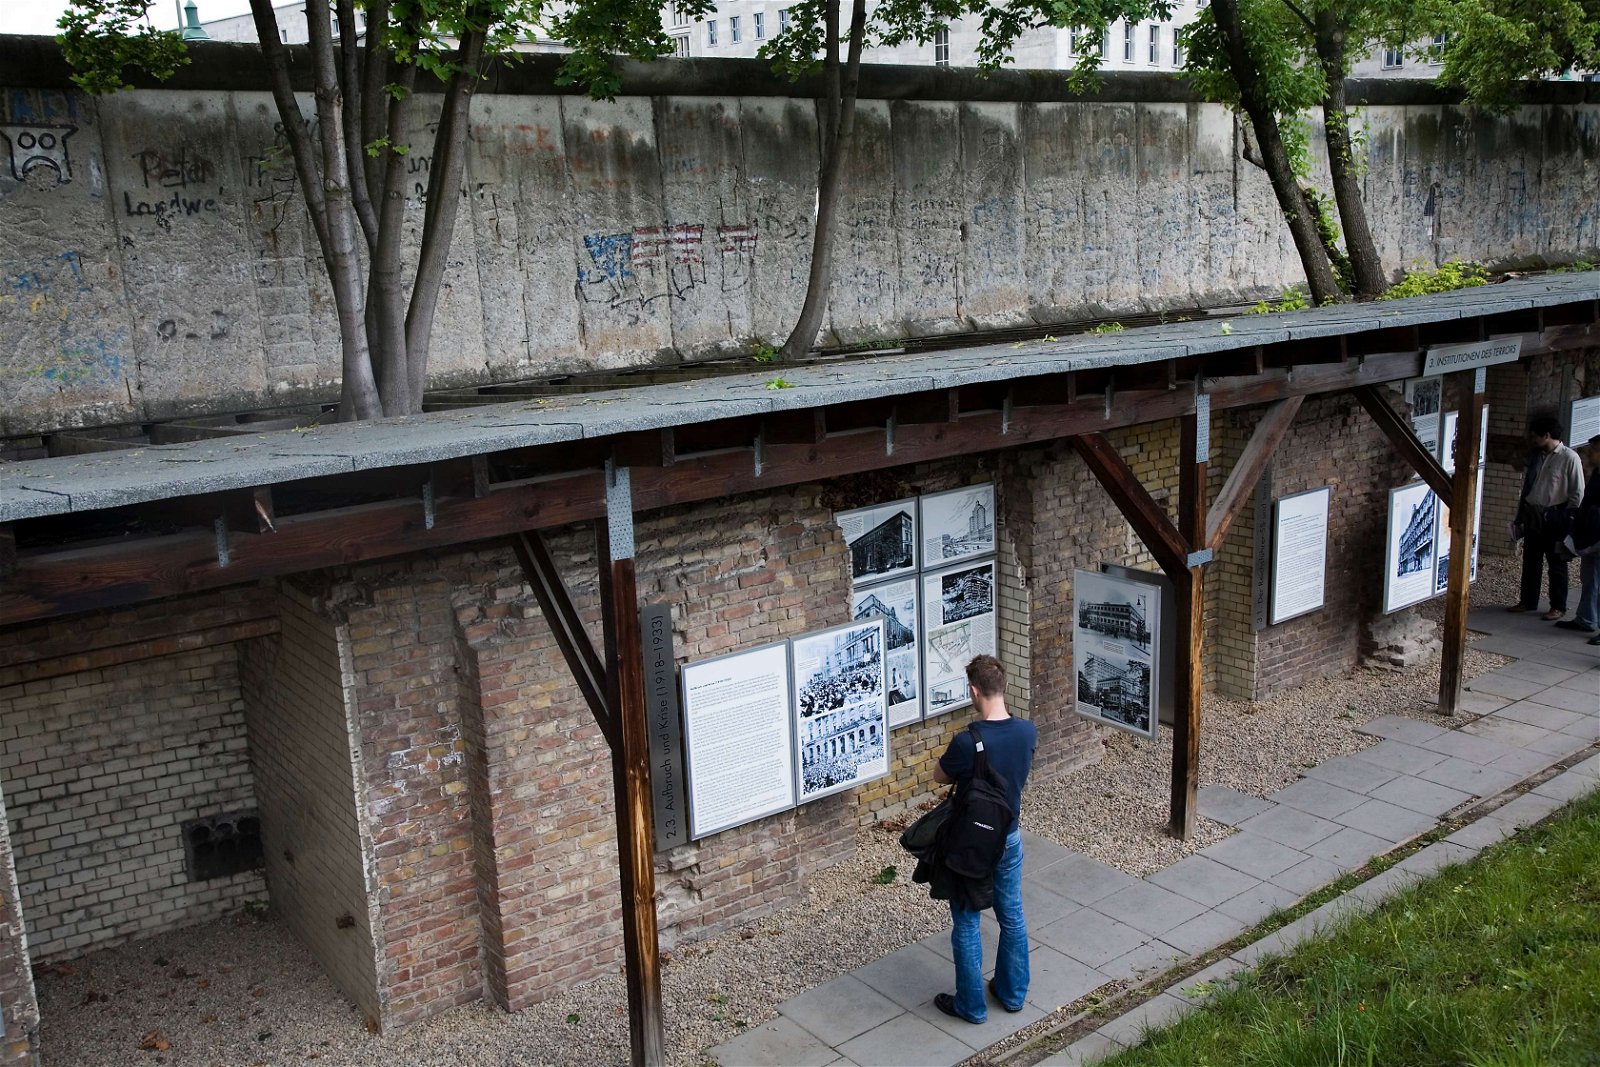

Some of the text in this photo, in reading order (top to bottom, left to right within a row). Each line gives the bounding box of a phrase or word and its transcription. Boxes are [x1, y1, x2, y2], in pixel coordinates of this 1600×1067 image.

[1429, 345, 1517, 368] 3. INSTITUTIONEN DES TERRORS
[657, 700, 669, 729] Krise
[658, 733, 671, 755] und
[661, 759, 674, 811] Aufbruch
[665, 815, 677, 839] 2.3.
